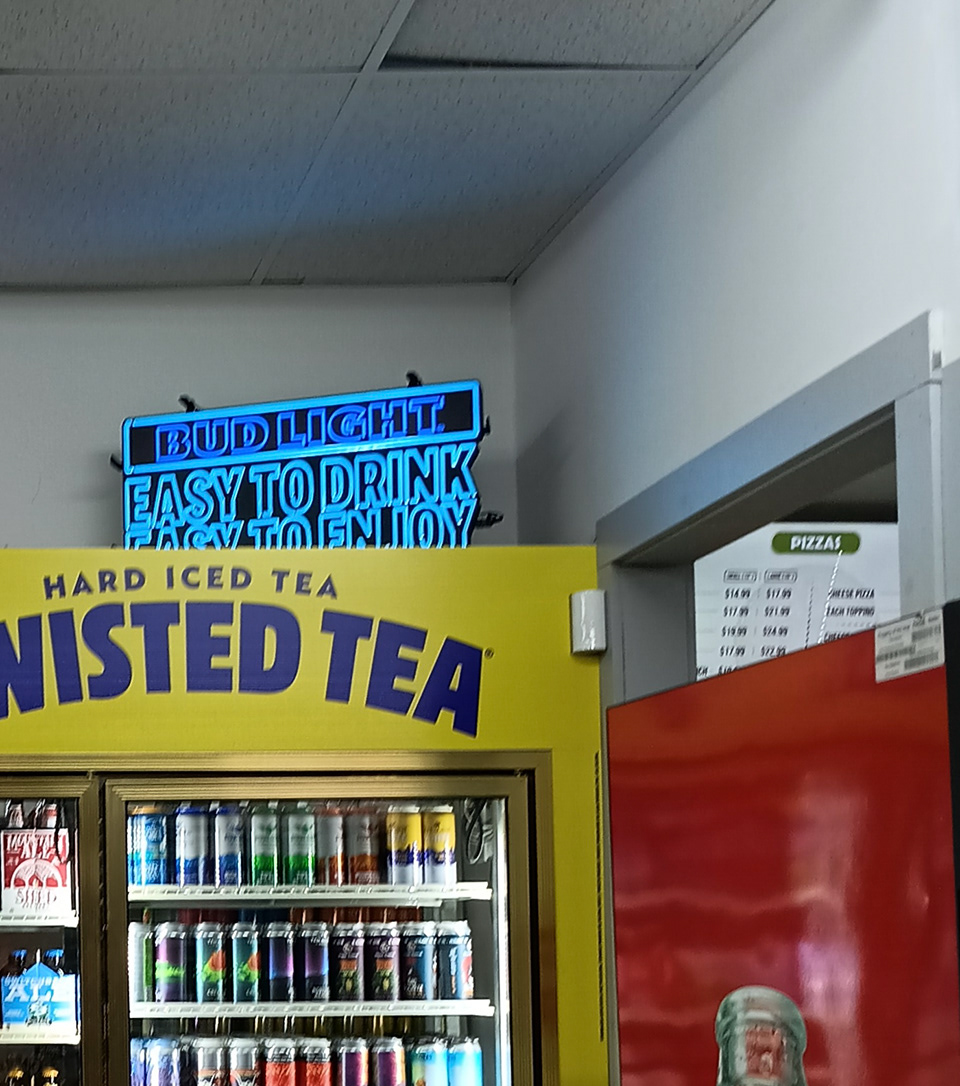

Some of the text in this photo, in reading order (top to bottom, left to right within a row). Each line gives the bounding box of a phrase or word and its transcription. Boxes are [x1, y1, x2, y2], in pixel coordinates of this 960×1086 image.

[155, 414, 270, 462] BUD
[124, 441, 477, 531] EASY TO DRINK
[790, 535, 842, 551] PIZZAS
[43, 564, 339, 600] HARD ICED TEA
[320, 608, 485, 738] TEA
